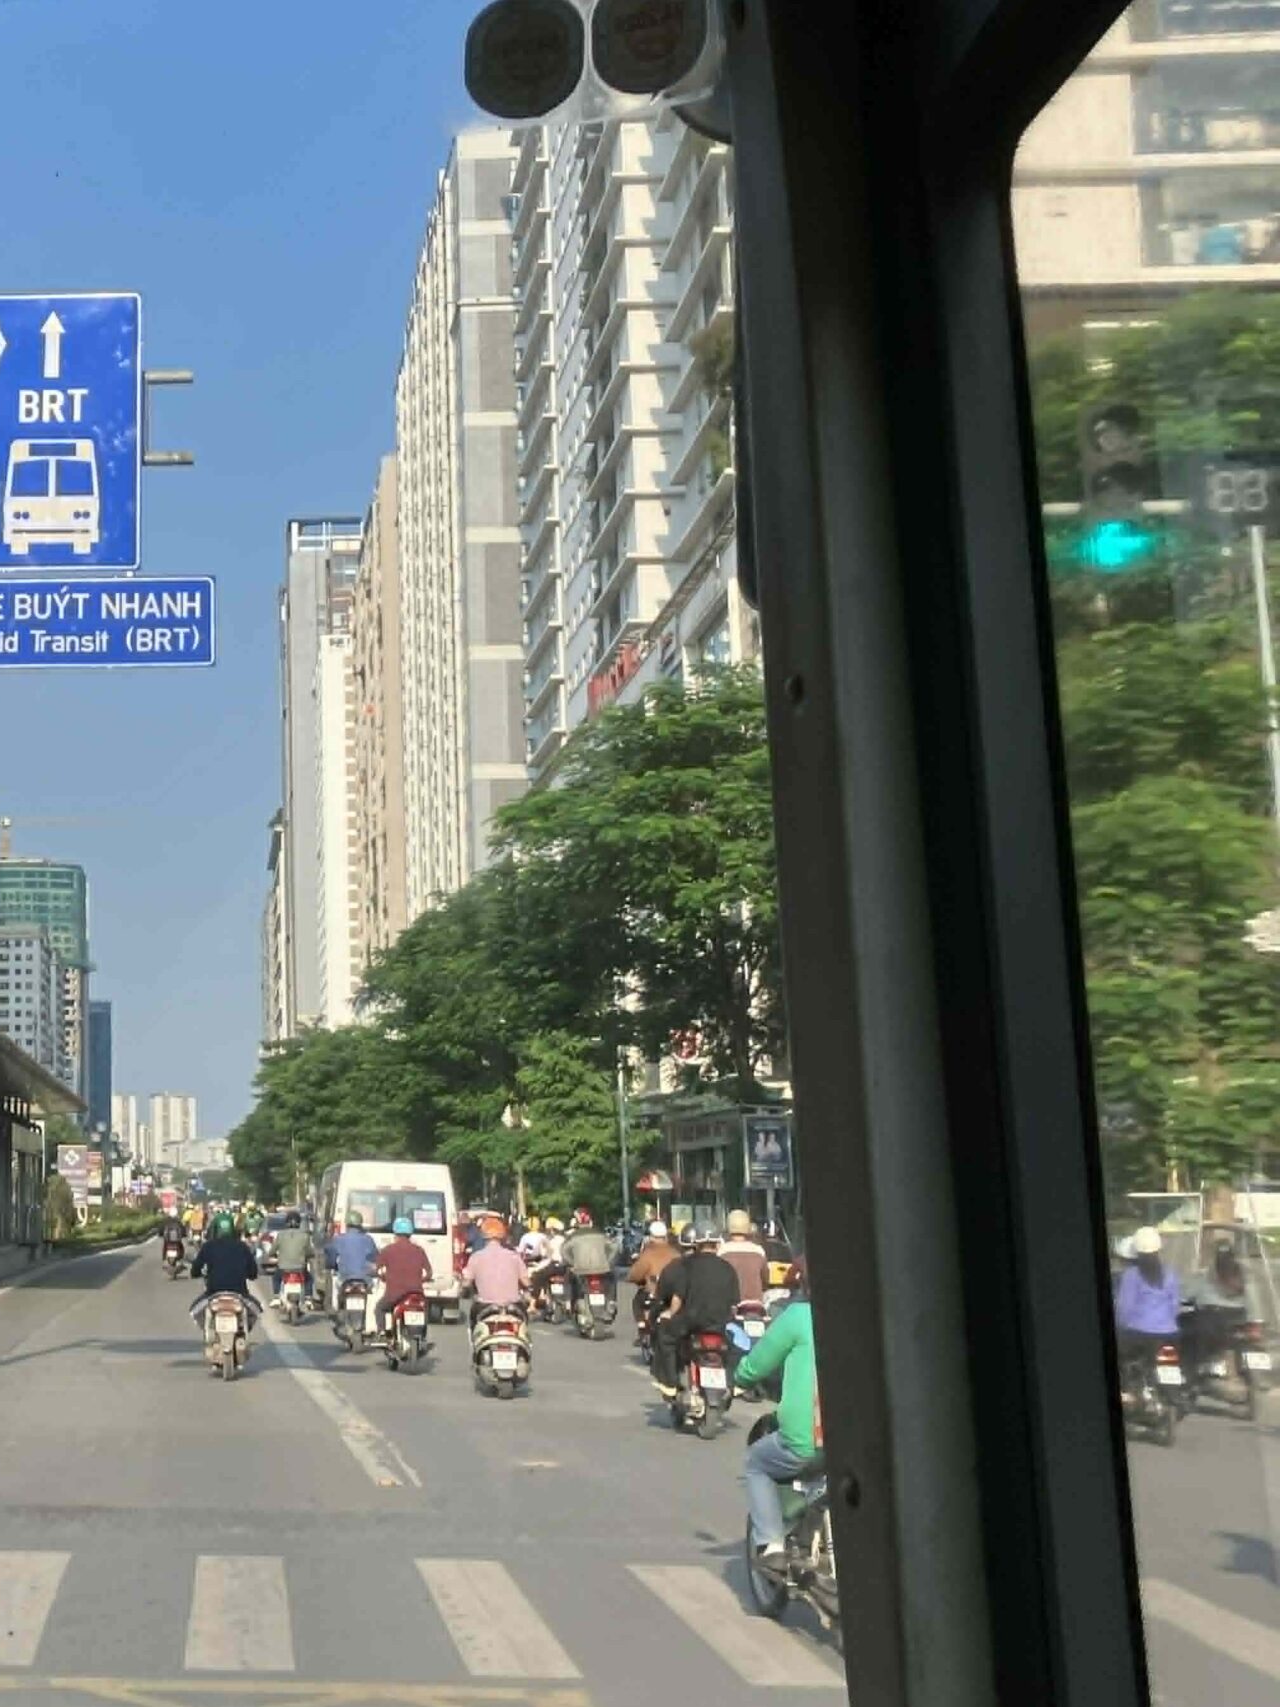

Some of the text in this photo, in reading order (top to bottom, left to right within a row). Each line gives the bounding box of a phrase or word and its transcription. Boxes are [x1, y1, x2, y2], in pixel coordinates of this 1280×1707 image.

[18, 387, 89, 424] BRT
[13, 585, 90, 620] BUÝT
[100, 592, 201, 619] NHANH
[30, 629, 110, 654] Transit
[125, 626, 200, 653] (BRT)
